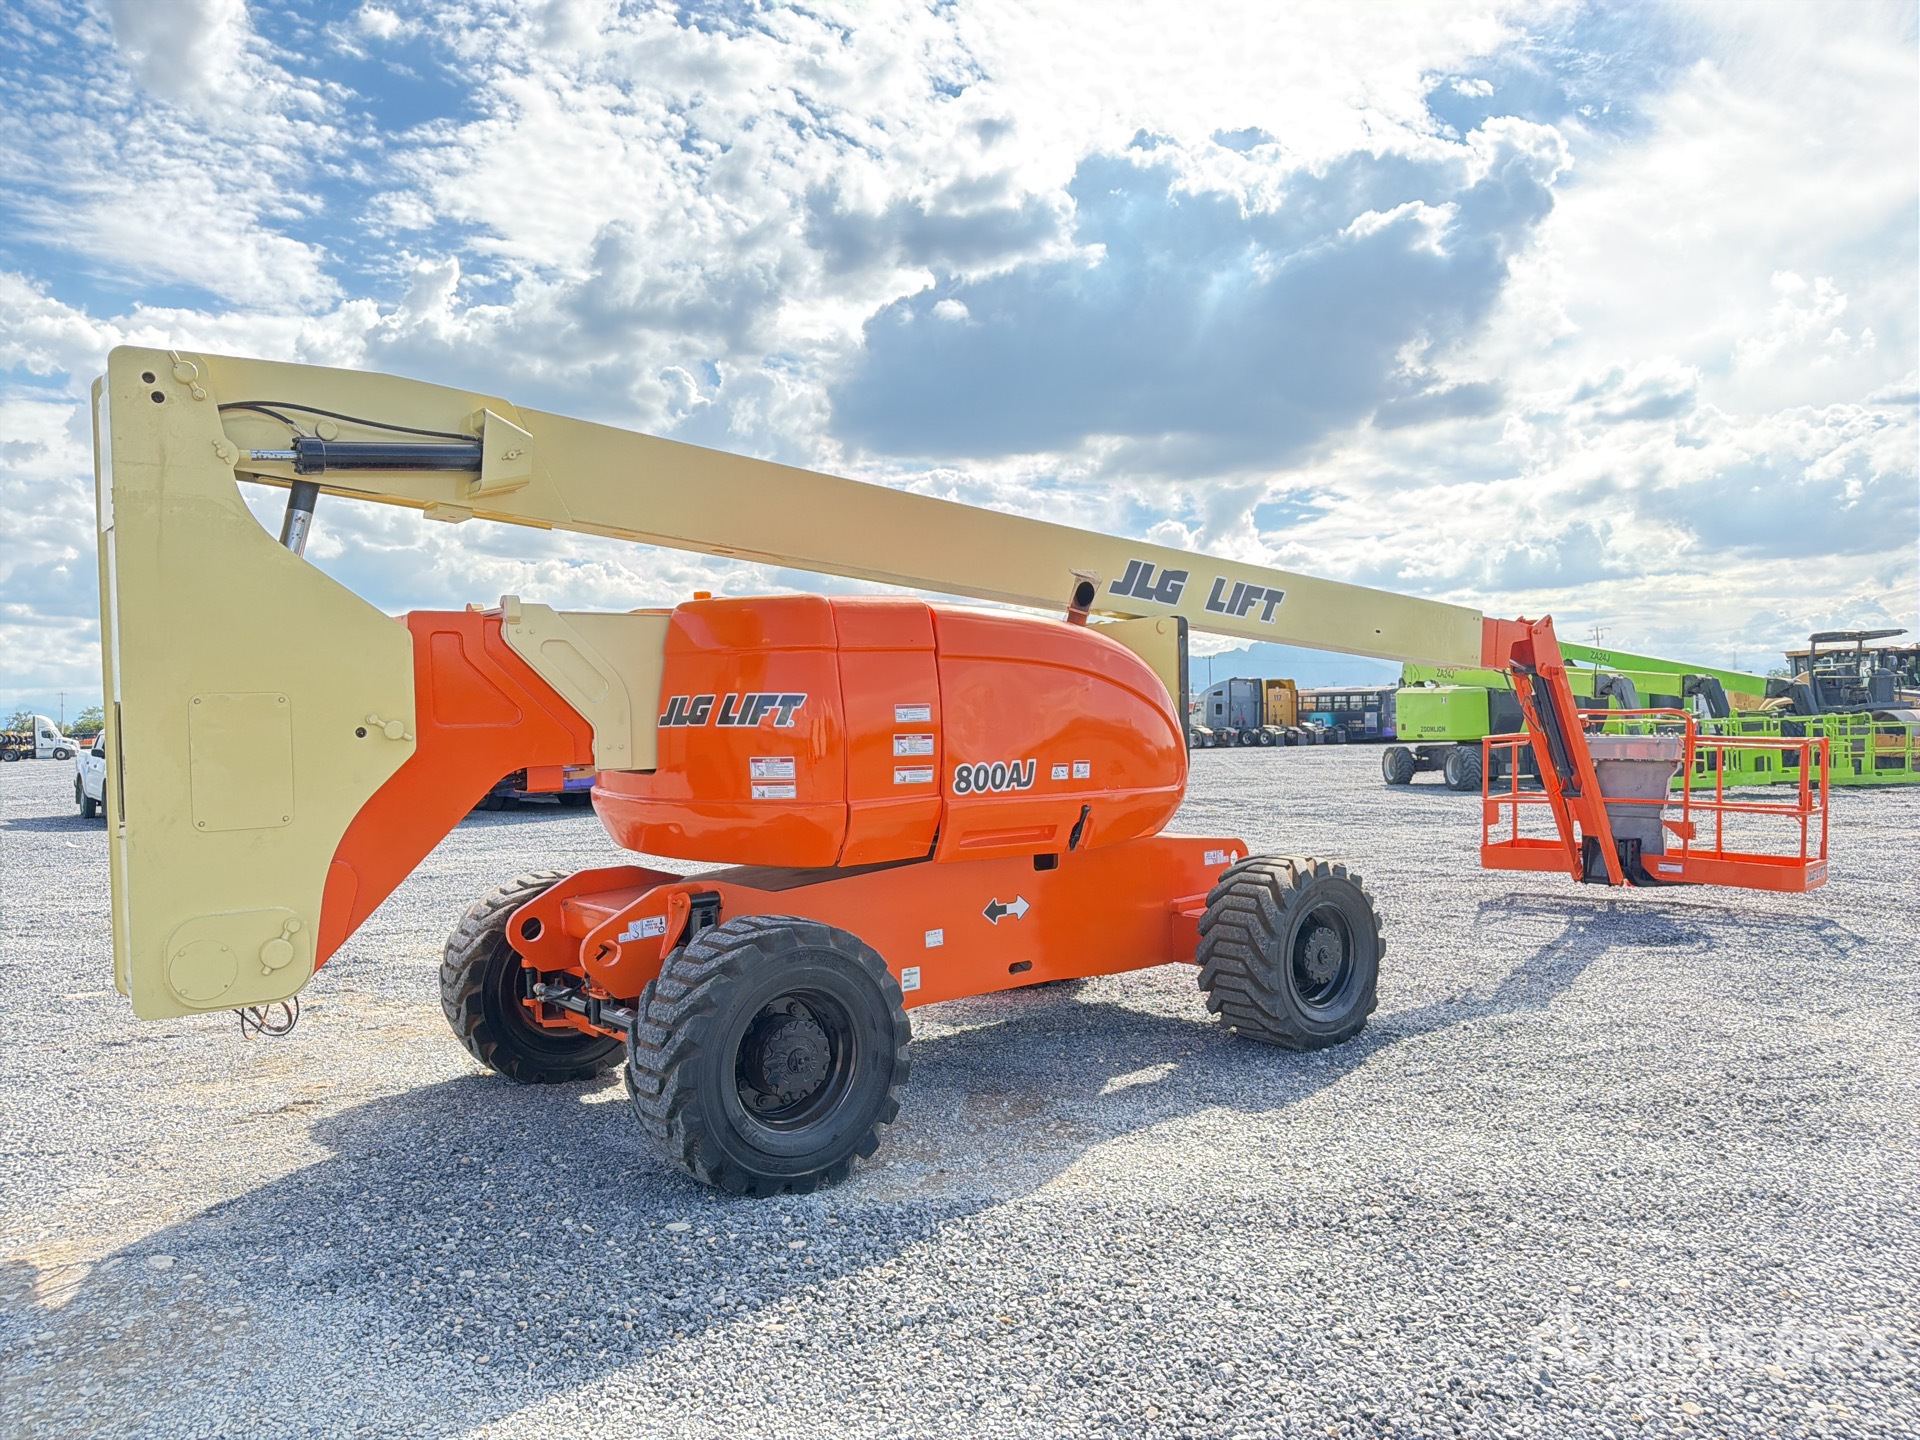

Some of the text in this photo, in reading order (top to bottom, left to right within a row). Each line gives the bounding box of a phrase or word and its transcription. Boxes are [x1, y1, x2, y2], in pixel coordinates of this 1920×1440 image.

[1108, 559, 1286, 623] JLG LIFT
[1436, 668, 1455, 679] ZA24J
[1590, 651, 1611, 662] ZA24J
[658, 692, 807, 728] JLG LIFT
[953, 759, 1037, 796] 800AJ
